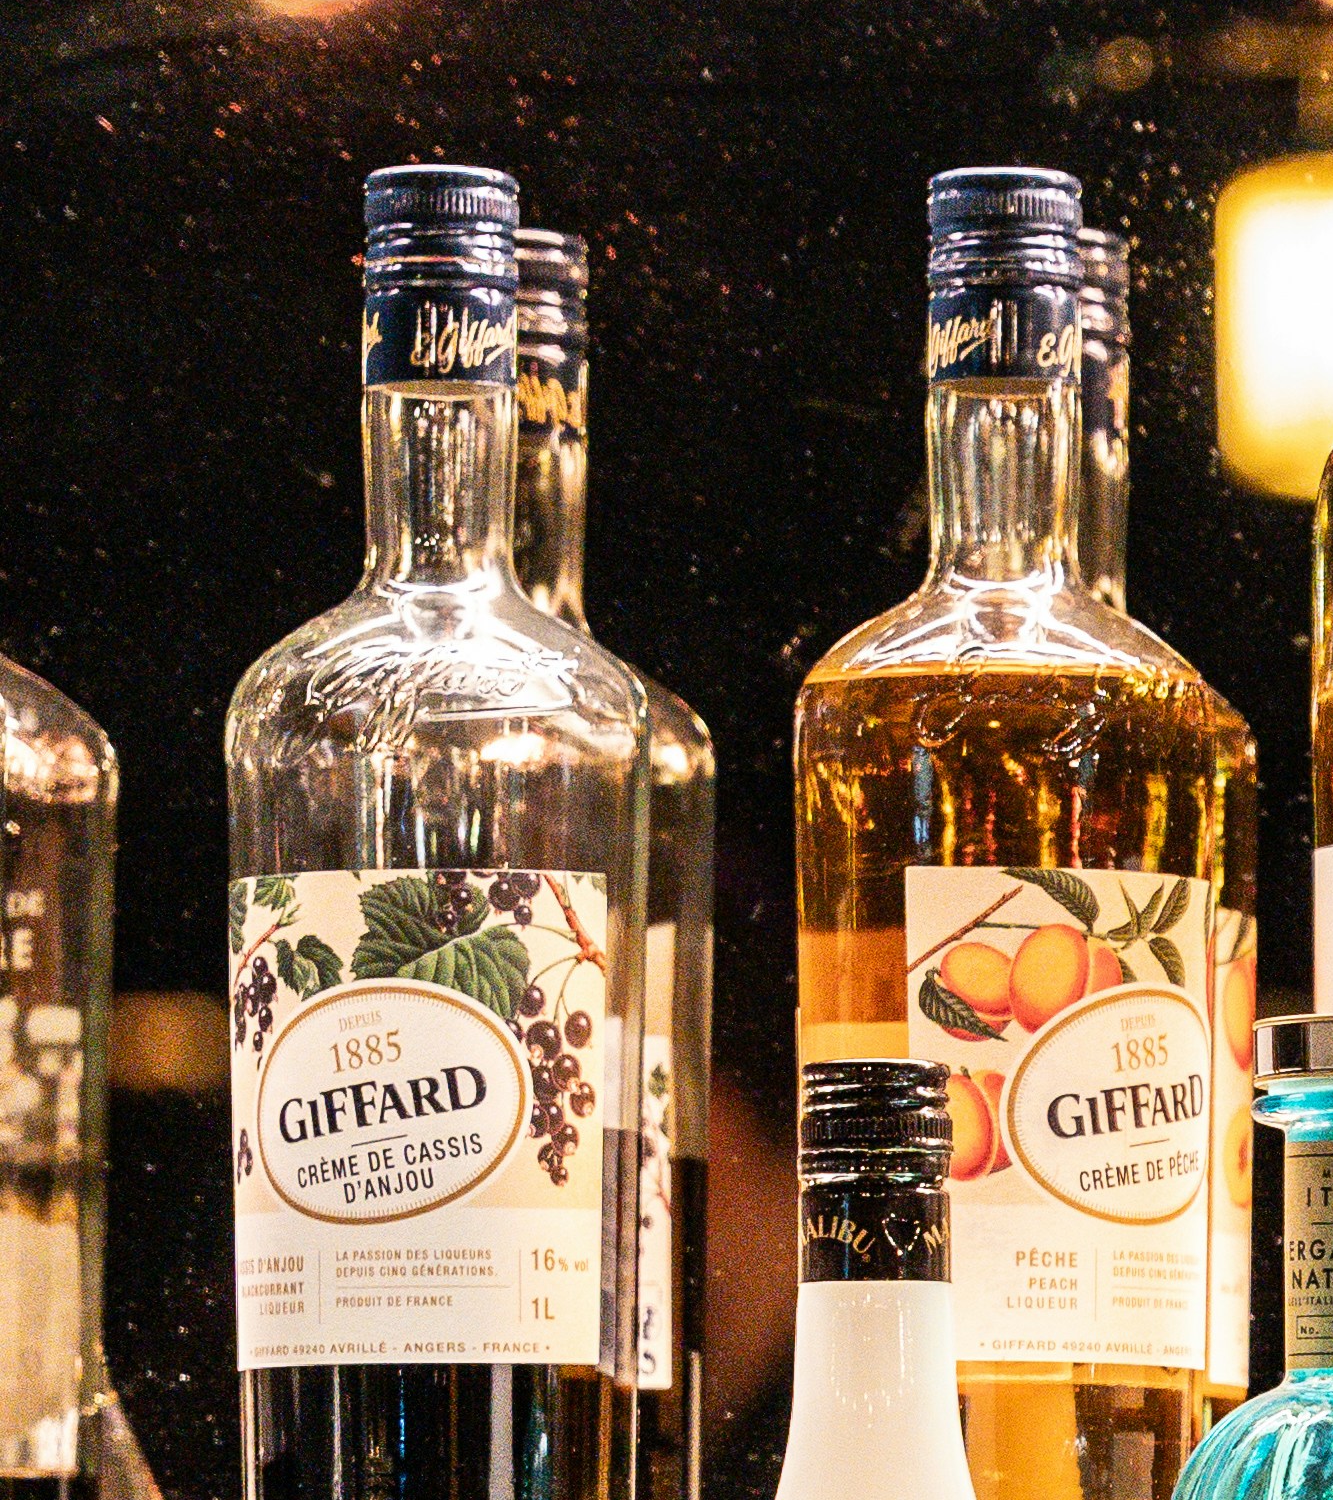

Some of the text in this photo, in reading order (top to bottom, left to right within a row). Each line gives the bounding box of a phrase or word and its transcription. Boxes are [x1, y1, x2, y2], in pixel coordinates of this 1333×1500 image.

[337, 1009, 383, 1033] DEPUIS
[330, 1028, 403, 1076] 1885
[1111, 1033, 1169, 1075] 1885
[278, 1063, 488, 1145] GIFFARD
[1047, 1071, 1204, 1142] GIFFARD
[297, 1132, 484, 1191] CRÈME DE CASSIS
[1079, 1157, 1141, 1192] CRÈME
[1146, 1156, 1166, 1183] DE
[343, 1168, 436, 1205] D'ANJOU
[335, 1247, 493, 1262] LA PASSION DES LIQUEURS
[530, 1247, 568, 1272] 16%
[1015, 1246, 1079, 1270] PÊCHE
[1028, 1275, 1079, 1291] PEACH
[530, 1296, 555, 1321] 1L
[1006, 1295, 1079, 1312] LIQUEUR
